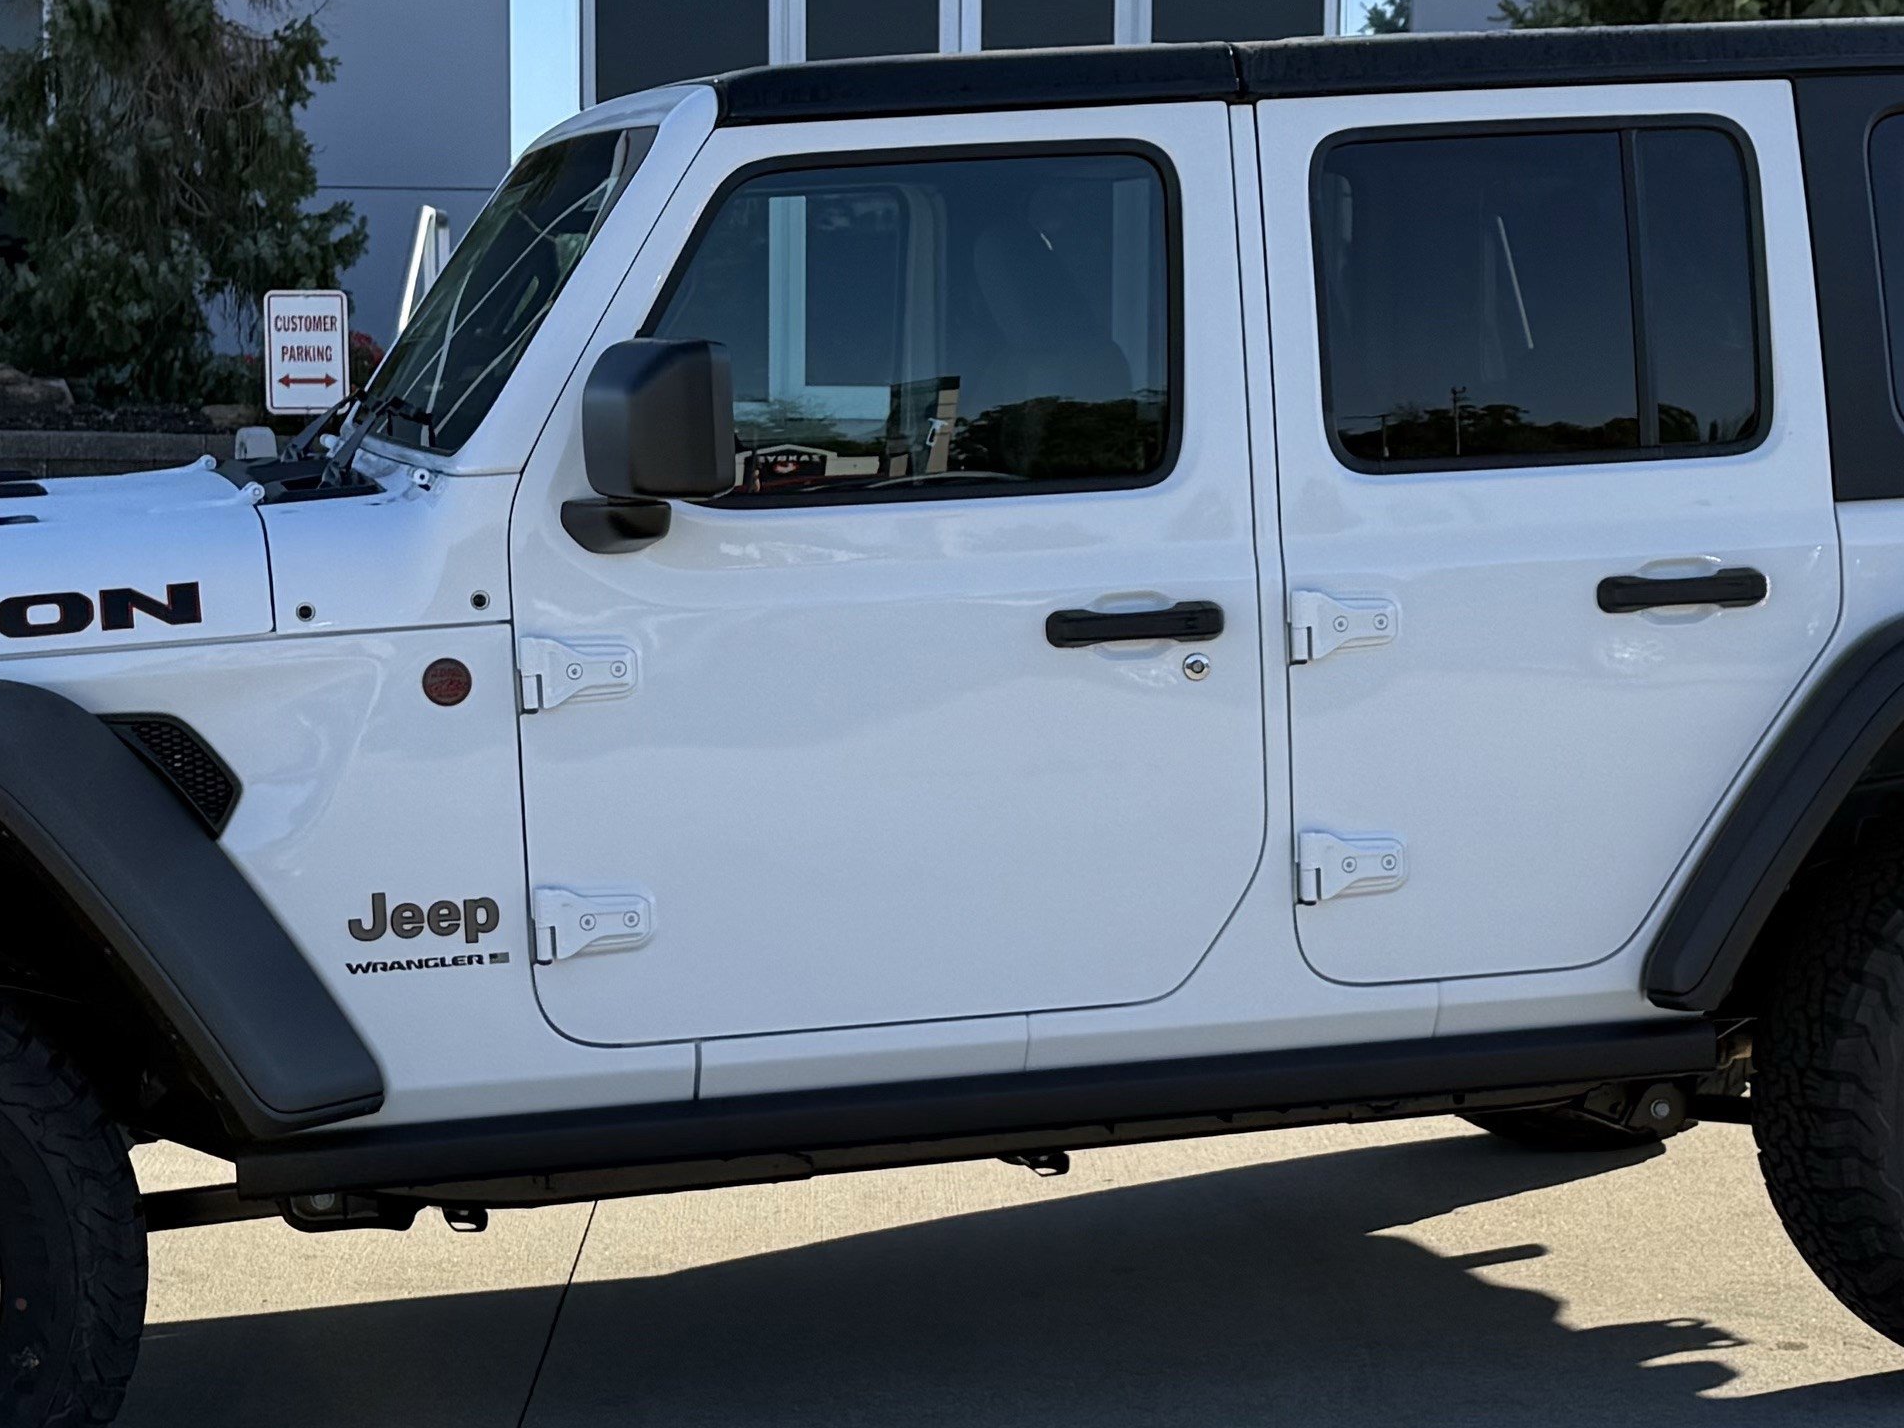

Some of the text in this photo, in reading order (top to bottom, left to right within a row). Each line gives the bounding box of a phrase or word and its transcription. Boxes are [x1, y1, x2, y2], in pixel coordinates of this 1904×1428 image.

[274, 315, 338, 333] CUSTOMER
[281, 344, 333, 363] PARKING
[348, 892, 500, 944] Jeep
[346, 953, 484, 975] WRANGLER
